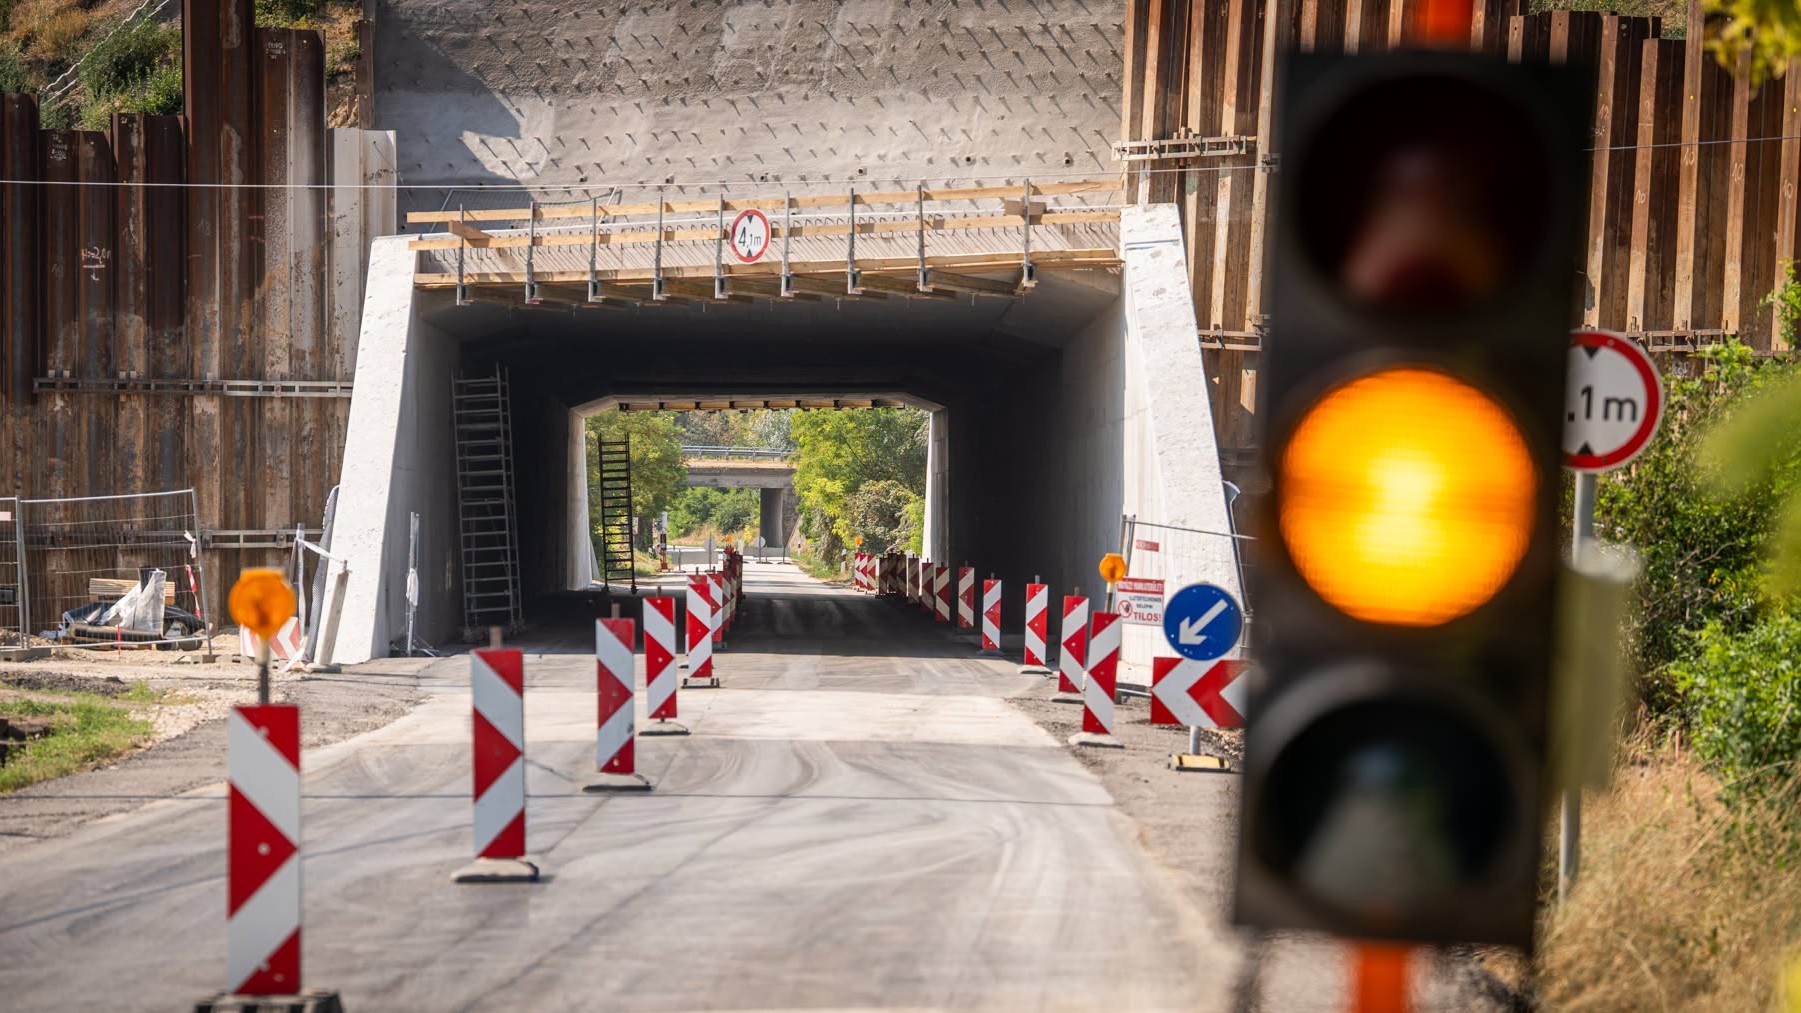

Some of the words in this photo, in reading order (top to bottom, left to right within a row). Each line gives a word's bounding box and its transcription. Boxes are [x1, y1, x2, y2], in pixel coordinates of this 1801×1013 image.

[1683, 147, 1695, 166] 10
[1731, 162, 1744, 182] 10
[1782, 178, 1793, 199] 10
[1134, 611, 1161, 622] TILOS!
